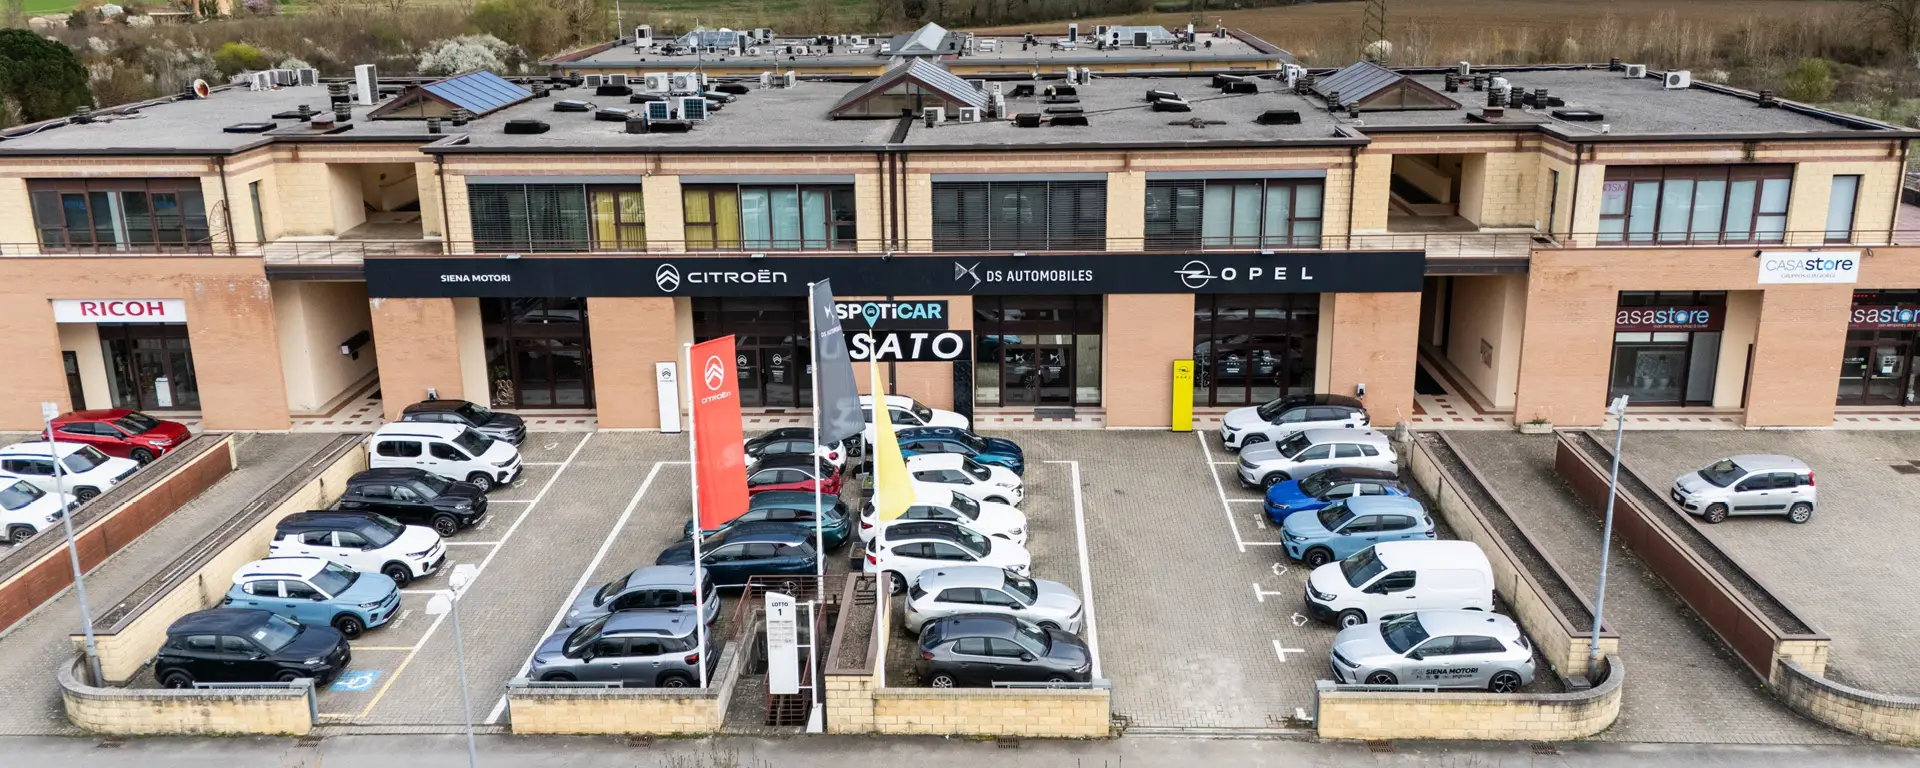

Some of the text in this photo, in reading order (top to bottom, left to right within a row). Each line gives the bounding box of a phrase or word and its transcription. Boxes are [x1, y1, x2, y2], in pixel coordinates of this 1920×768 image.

[1766, 258, 1853, 271] CASAstore
[440, 274, 511, 282] SIENA MOTORI
[986, 270, 1093, 282] DS AUTOMOBILES
[1221, 266, 1313, 280] OPEL
[80, 301, 165, 317] RICOH
[1849, 305, 1920, 323] sastor
